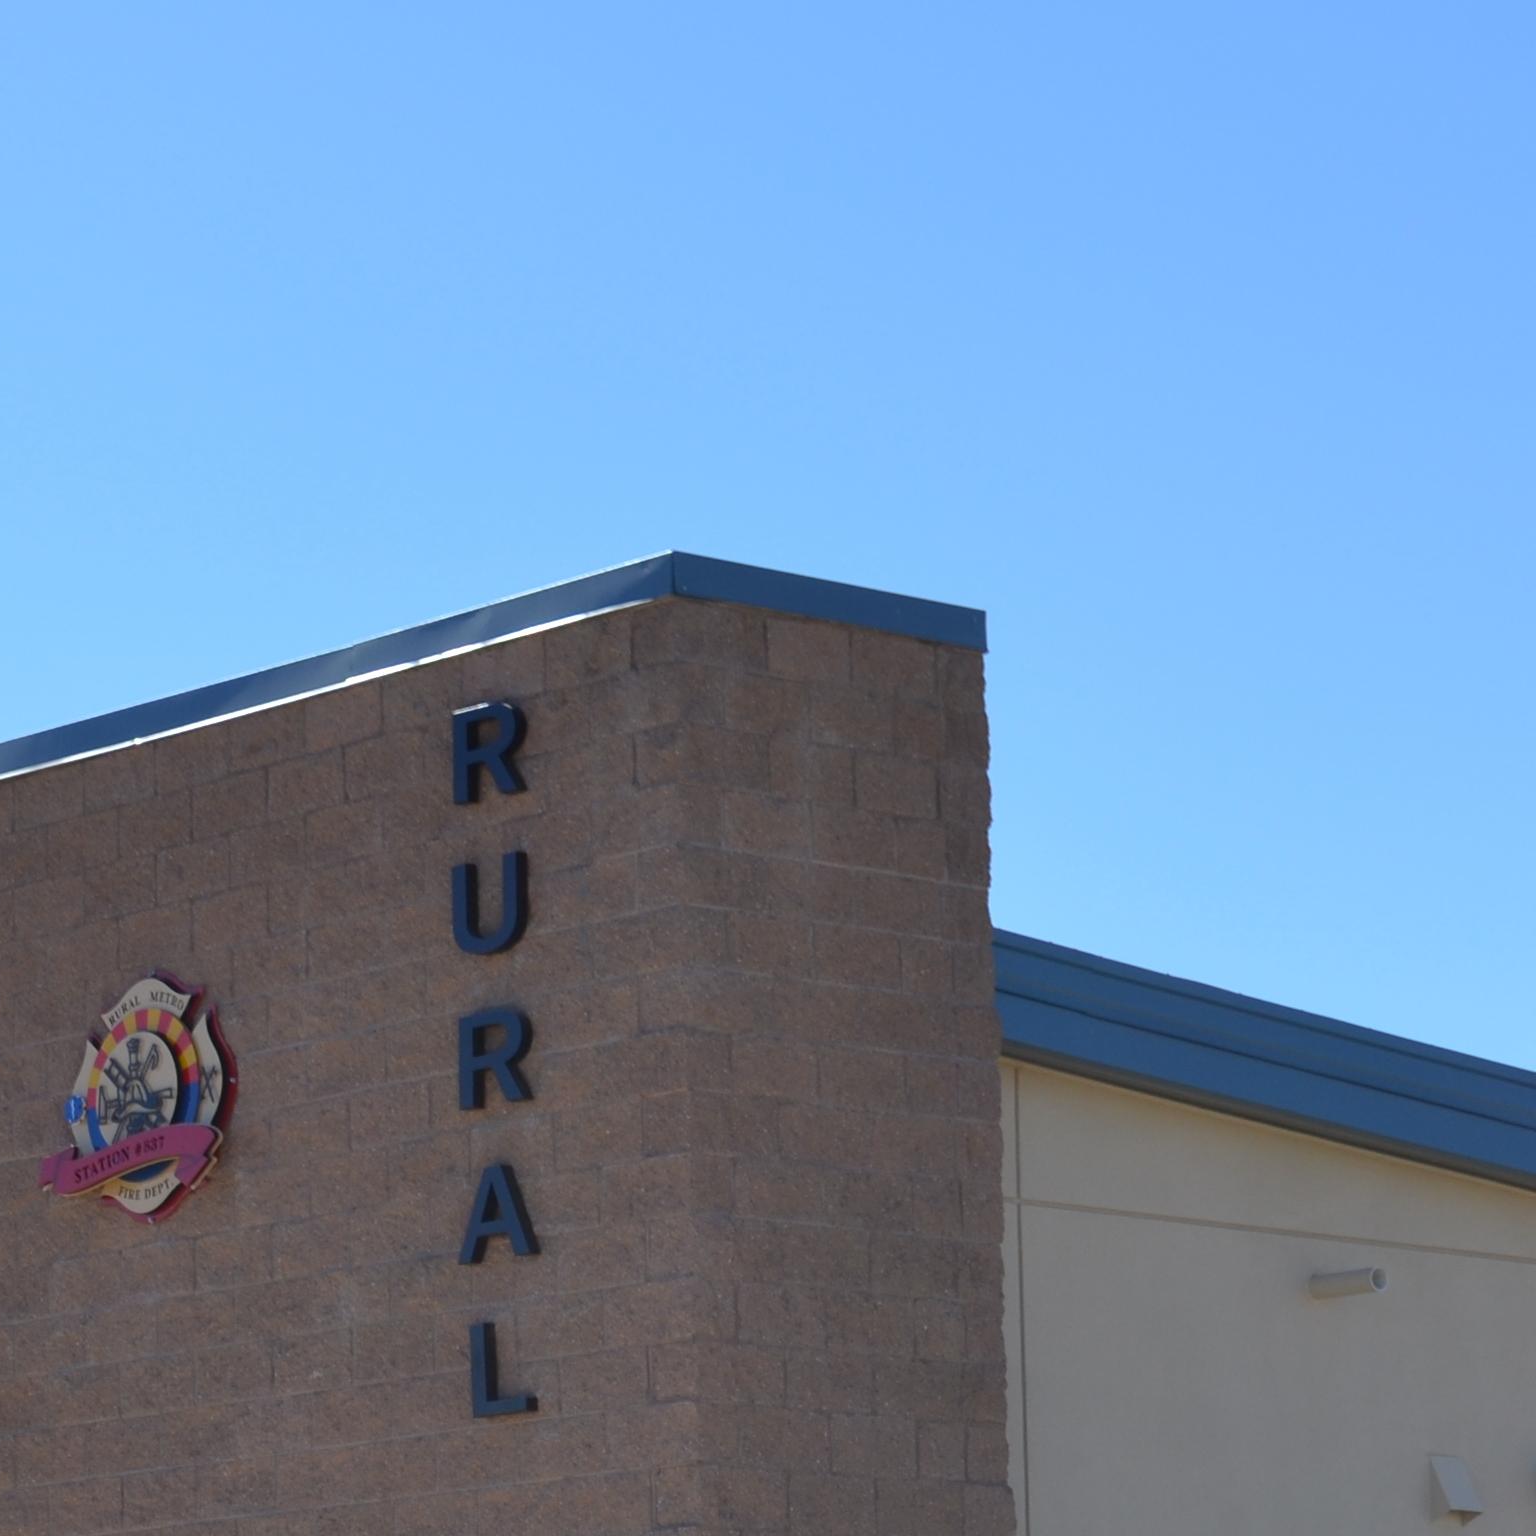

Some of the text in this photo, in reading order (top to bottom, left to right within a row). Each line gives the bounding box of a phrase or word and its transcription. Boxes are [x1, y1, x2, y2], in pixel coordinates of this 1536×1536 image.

[108, 991, 184, 1026] RURAL METRO
[451, 702, 541, 1419] RURAL
[74, 1136, 165, 1184] STATION #837
[118, 1178, 175, 1201] FIRE DEPT.
